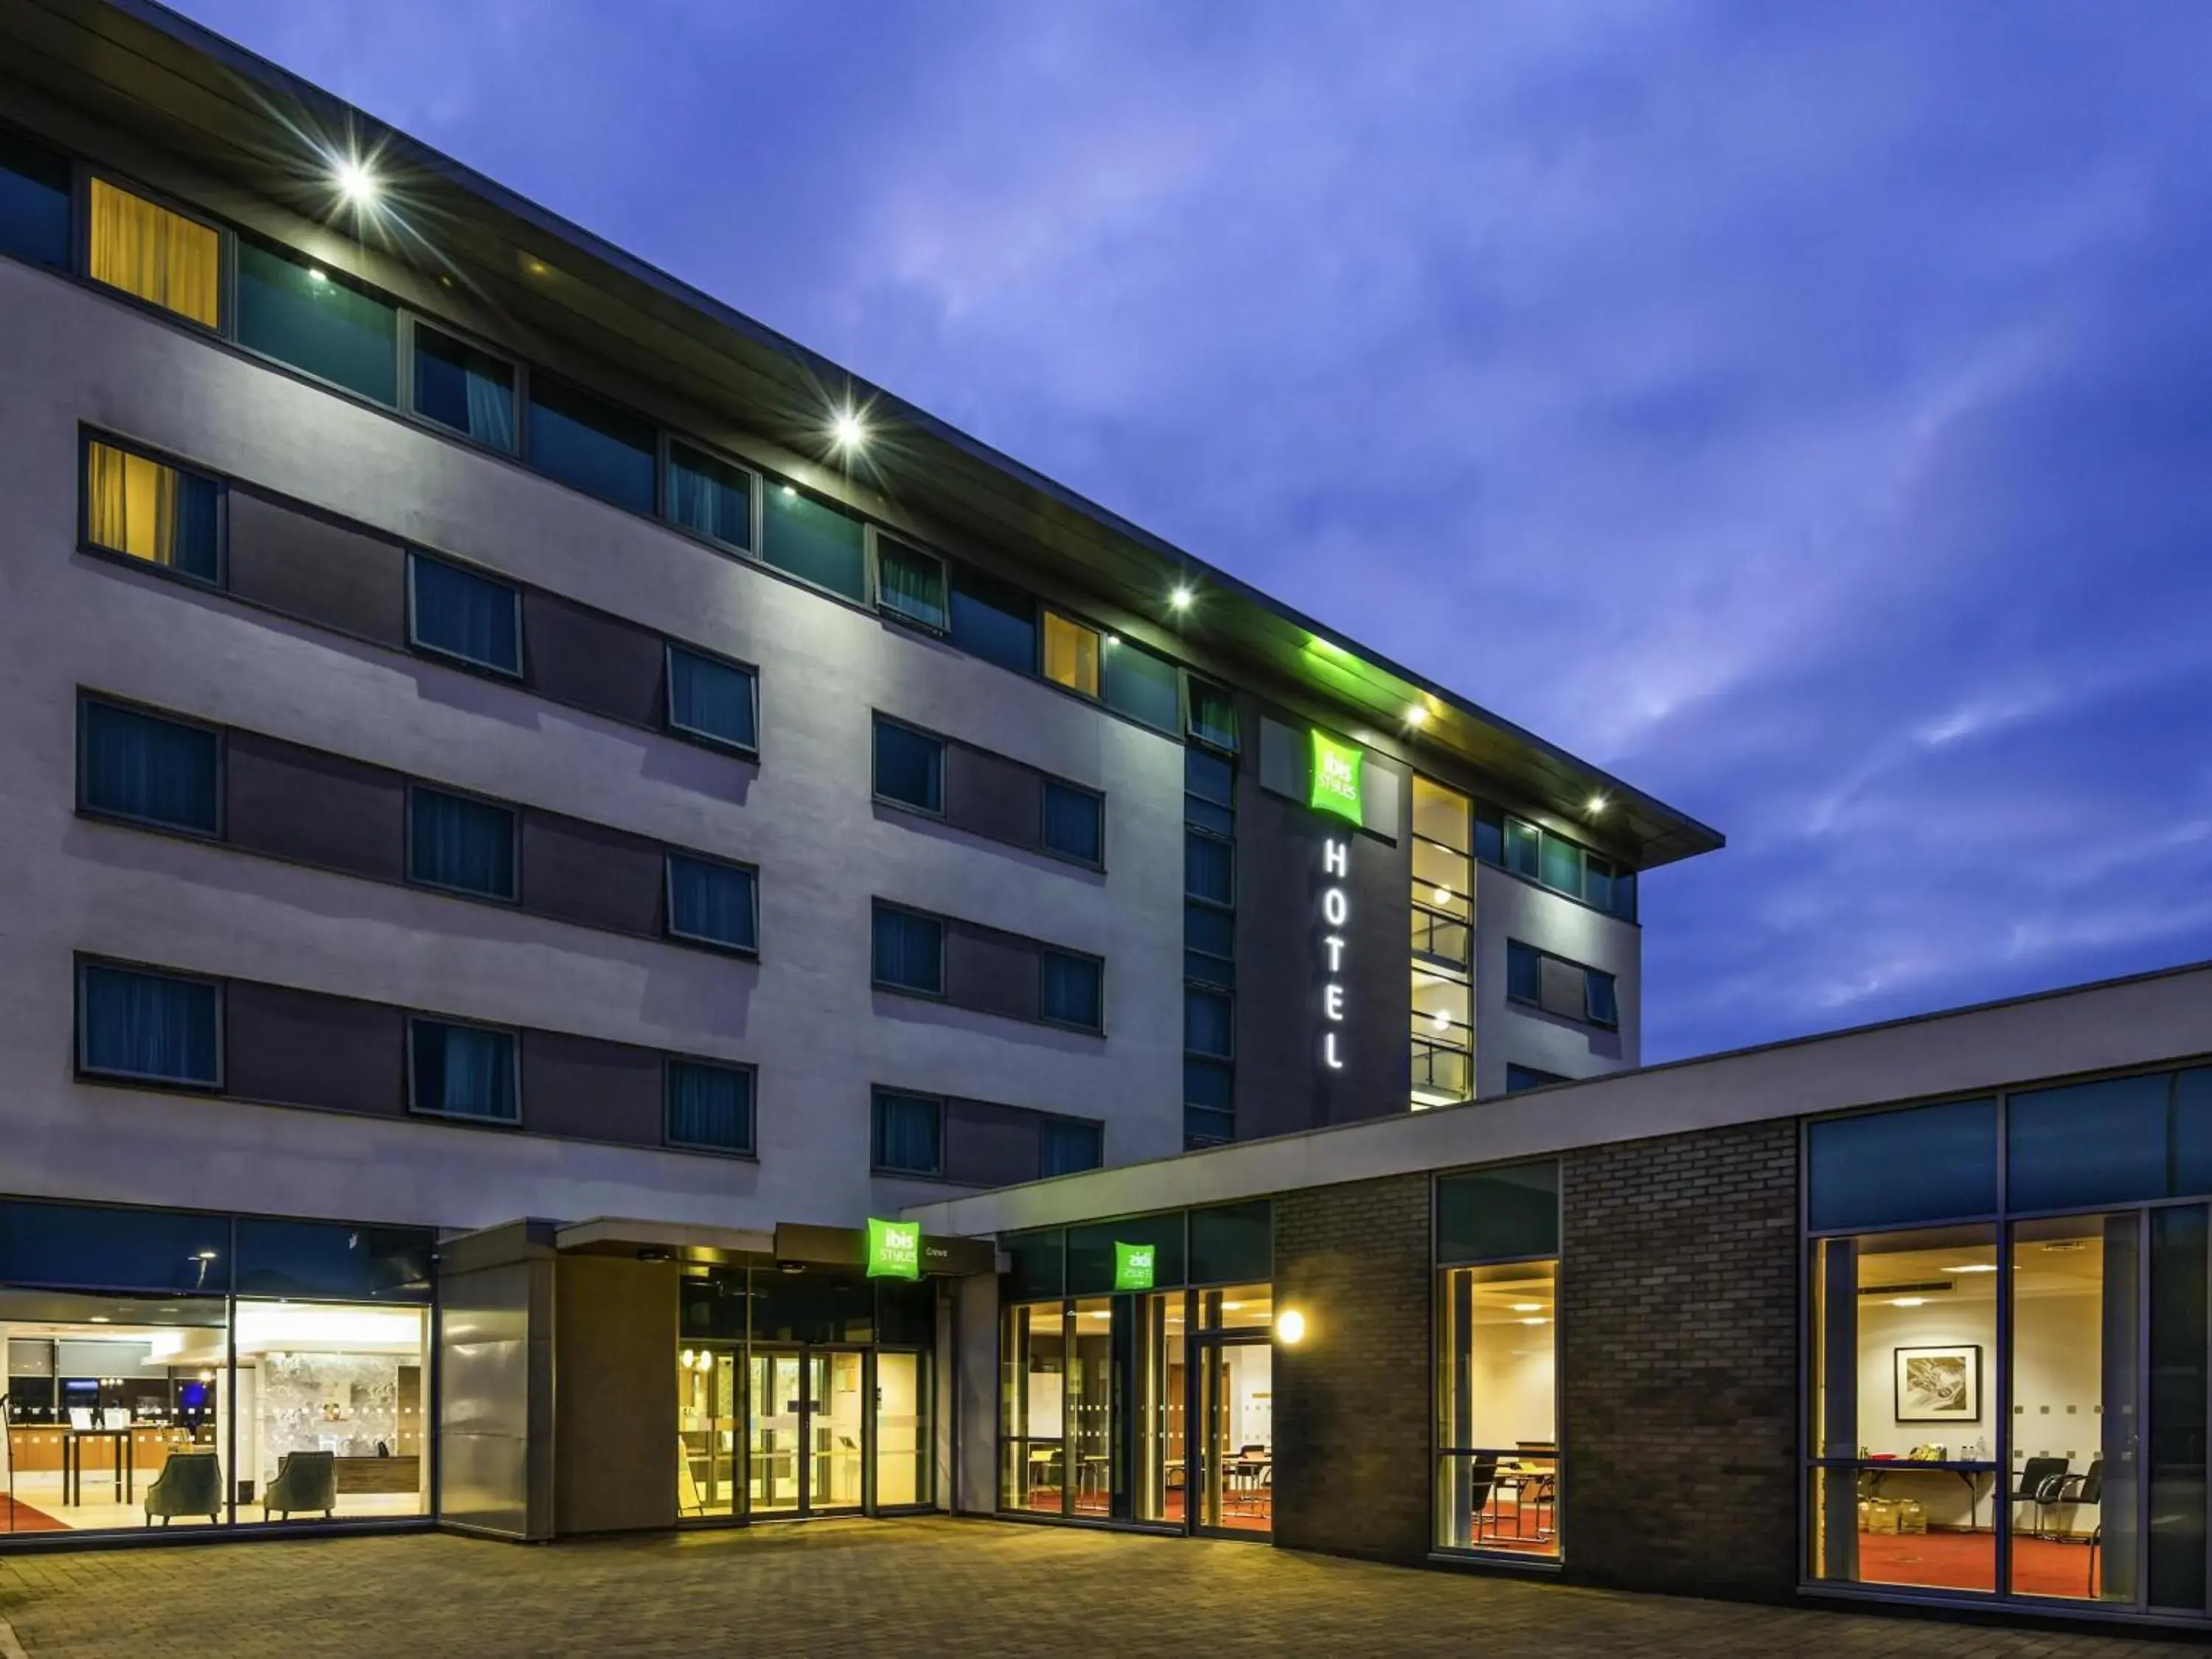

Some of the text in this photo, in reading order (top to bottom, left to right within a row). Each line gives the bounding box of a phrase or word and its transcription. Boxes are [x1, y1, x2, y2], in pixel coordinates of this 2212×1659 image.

[1323, 751, 1352, 782] ibis
[1324, 838, 1348, 1069] HOTEL
[886, 1228, 914, 1249] ibis
